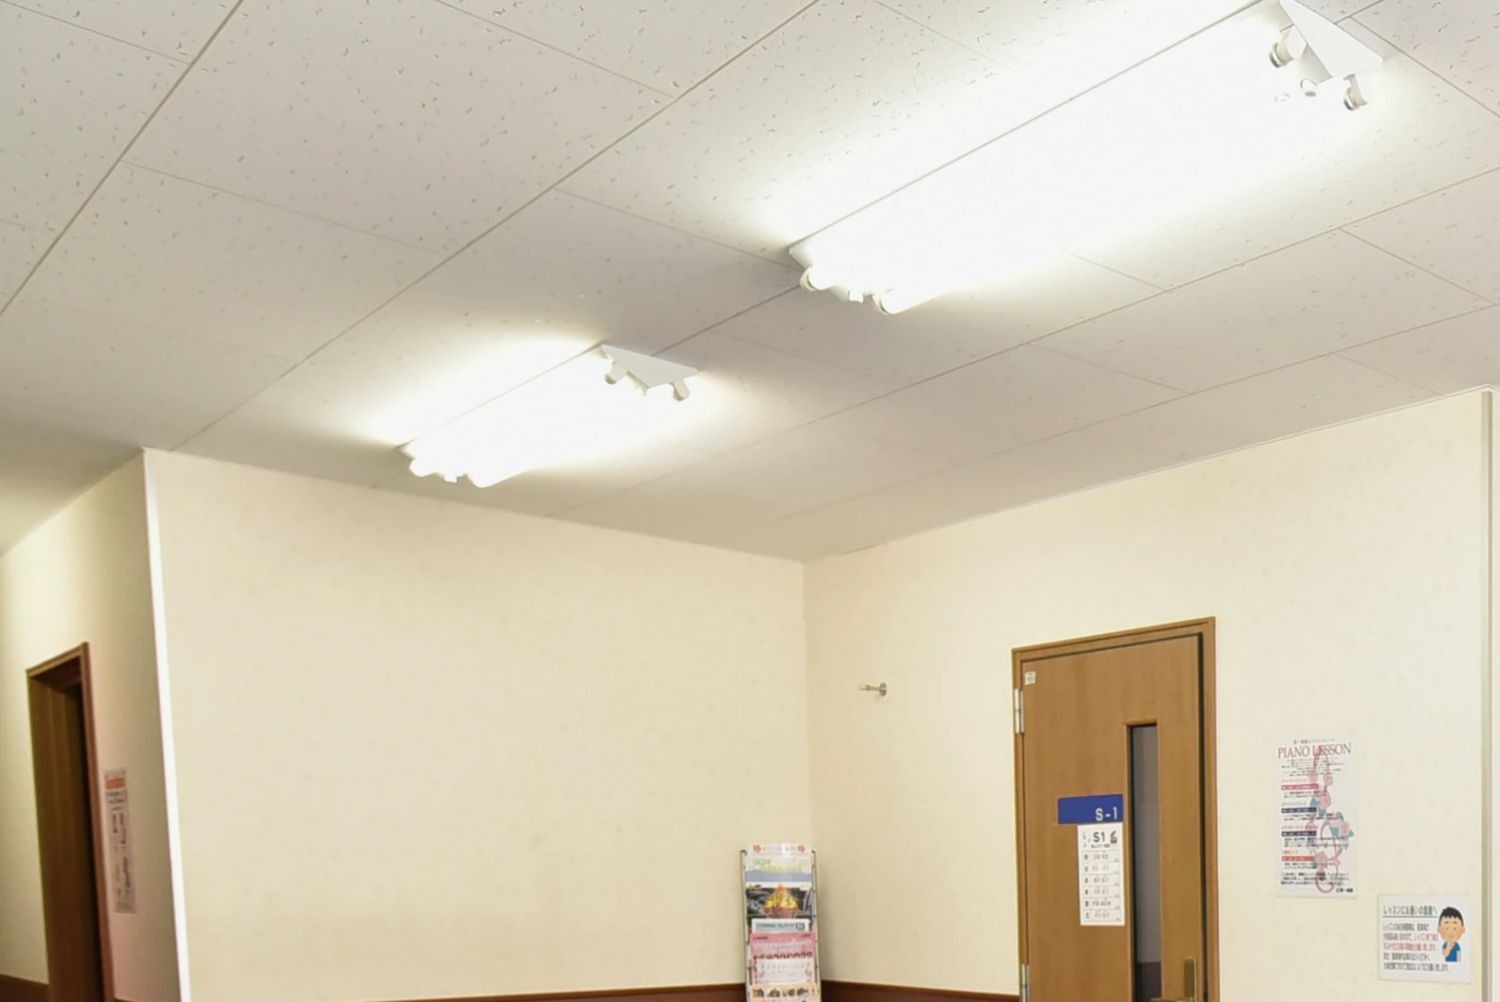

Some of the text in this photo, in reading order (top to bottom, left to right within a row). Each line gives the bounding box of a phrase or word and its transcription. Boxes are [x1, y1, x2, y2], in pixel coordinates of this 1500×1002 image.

[1278, 743, 1352, 759] PIANO LESSON
[1095, 806, 1118, 821] S-1
